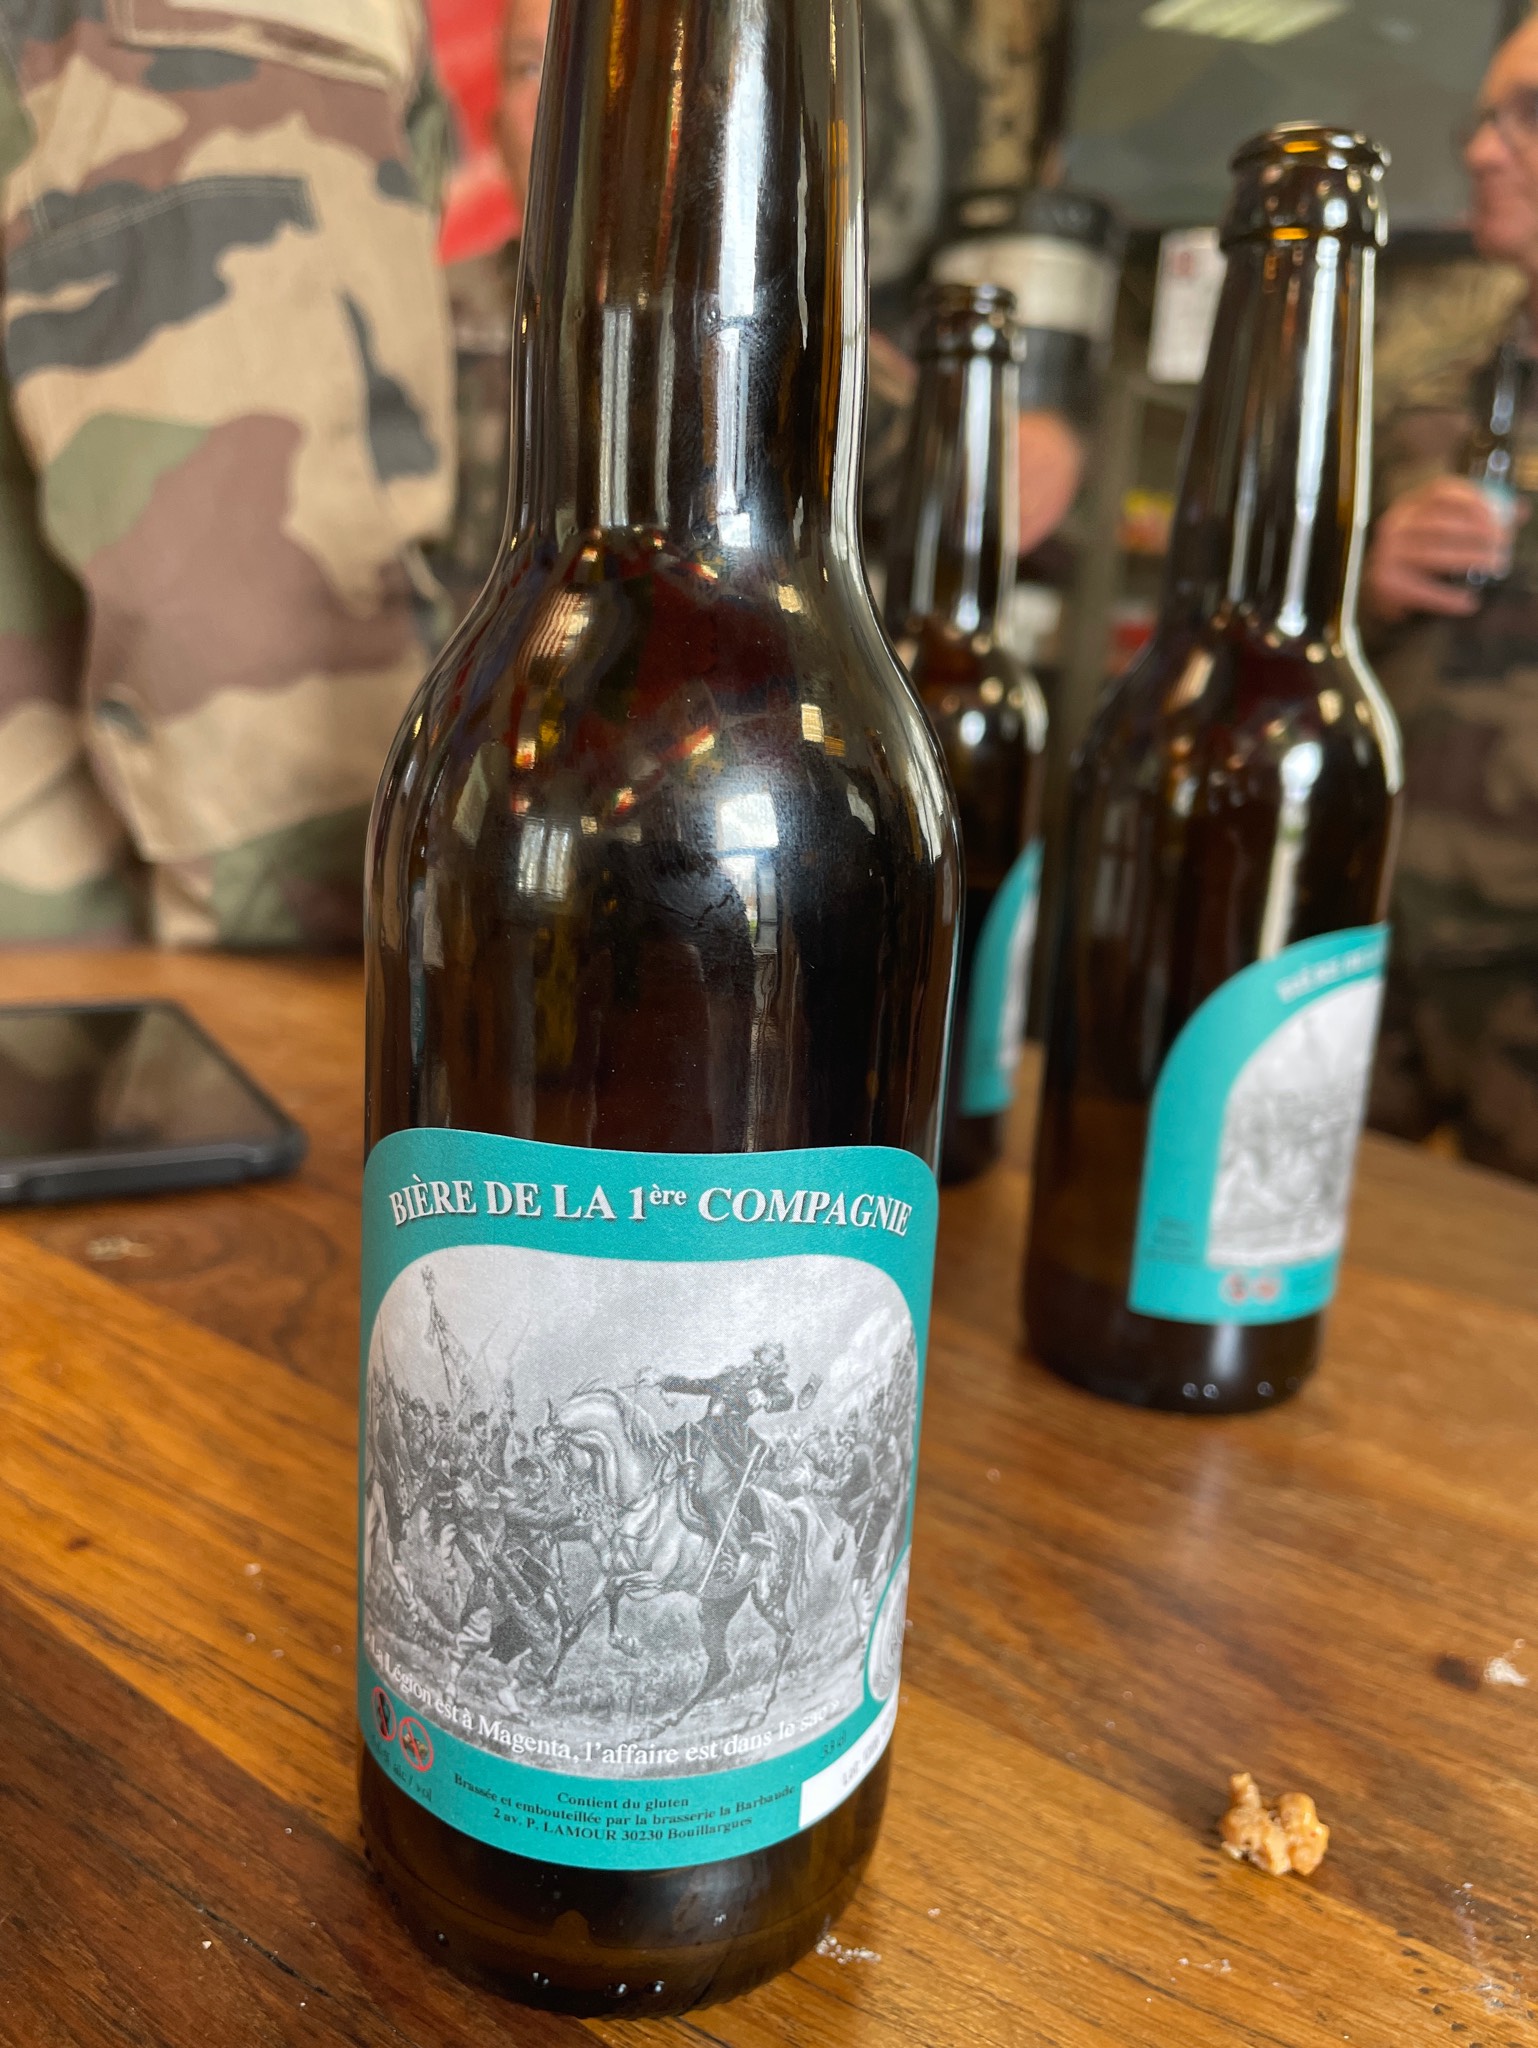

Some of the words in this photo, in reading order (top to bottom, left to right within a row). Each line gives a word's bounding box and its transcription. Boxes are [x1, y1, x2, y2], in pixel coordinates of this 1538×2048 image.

[389, 1173, 477, 1227] BIÈRE
[484, 1180, 542, 1218] DE
[551, 1184, 618, 1220] LA
[628, 1183, 688, 1221] 1ère
[697, 1186, 913, 1237] COMPAGNIE
[384, 1651, 432, 1708] Légion
[434, 1697, 459, 1724] est
[462, 1707, 474, 1730] à
[478, 1714, 579, 1763] Magenta,
[585, 1740, 680, 1766] l'affaire
[685, 1740, 719, 1761] est
[723, 1733, 773, 1756] dans
[779, 1719, 796, 1741] le
[454, 1772, 498, 1801] Brassée
[500, 1796, 512, 1807] et
[515, 1800, 602, 1824] embouteillée
[606, 1816, 631, 1827] par
[635, 1814, 648, 1826] la
[652, 1808, 716, 1826] brasserie
[719, 1805, 731, 1816] la
[735, 1784, 796, 1814] Barbaude
[493, 1807, 501, 1819] 2
[503, 1813, 523, 1826] av.
[526, 1817, 540, 1831] P.
[543, 1822, 617, 1841] LAMOUR
[621, 1829, 663, 1842] 30230
[667, 1816, 753, 1841] Bouillargues
[557, 1792, 618, 1809] Contient
[622, 1798, 641, 1810] du
[645, 1798, 689, 1811] gluten
